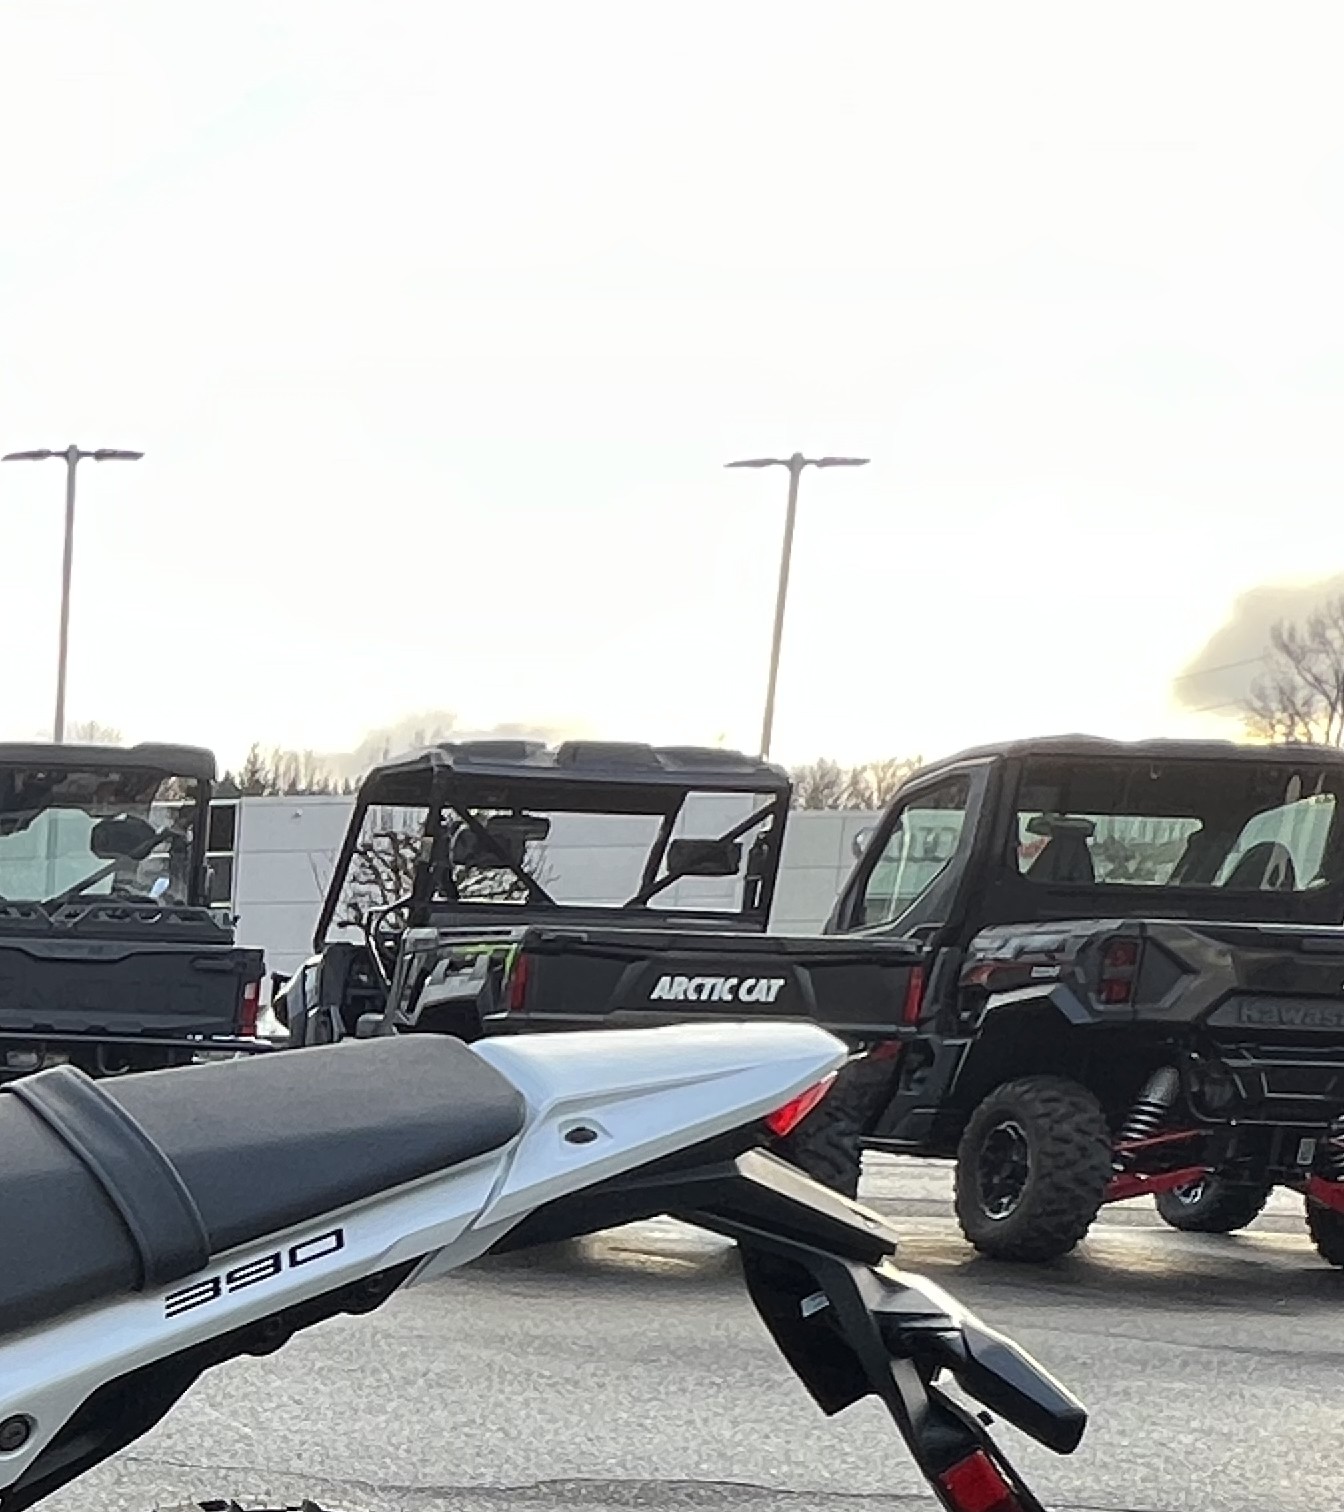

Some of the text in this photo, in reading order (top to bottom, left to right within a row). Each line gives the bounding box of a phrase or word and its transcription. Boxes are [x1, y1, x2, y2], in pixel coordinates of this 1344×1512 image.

[650, 976, 786, 1002] ARCTIC CAT
[164, 1228, 344, 1319] 390
